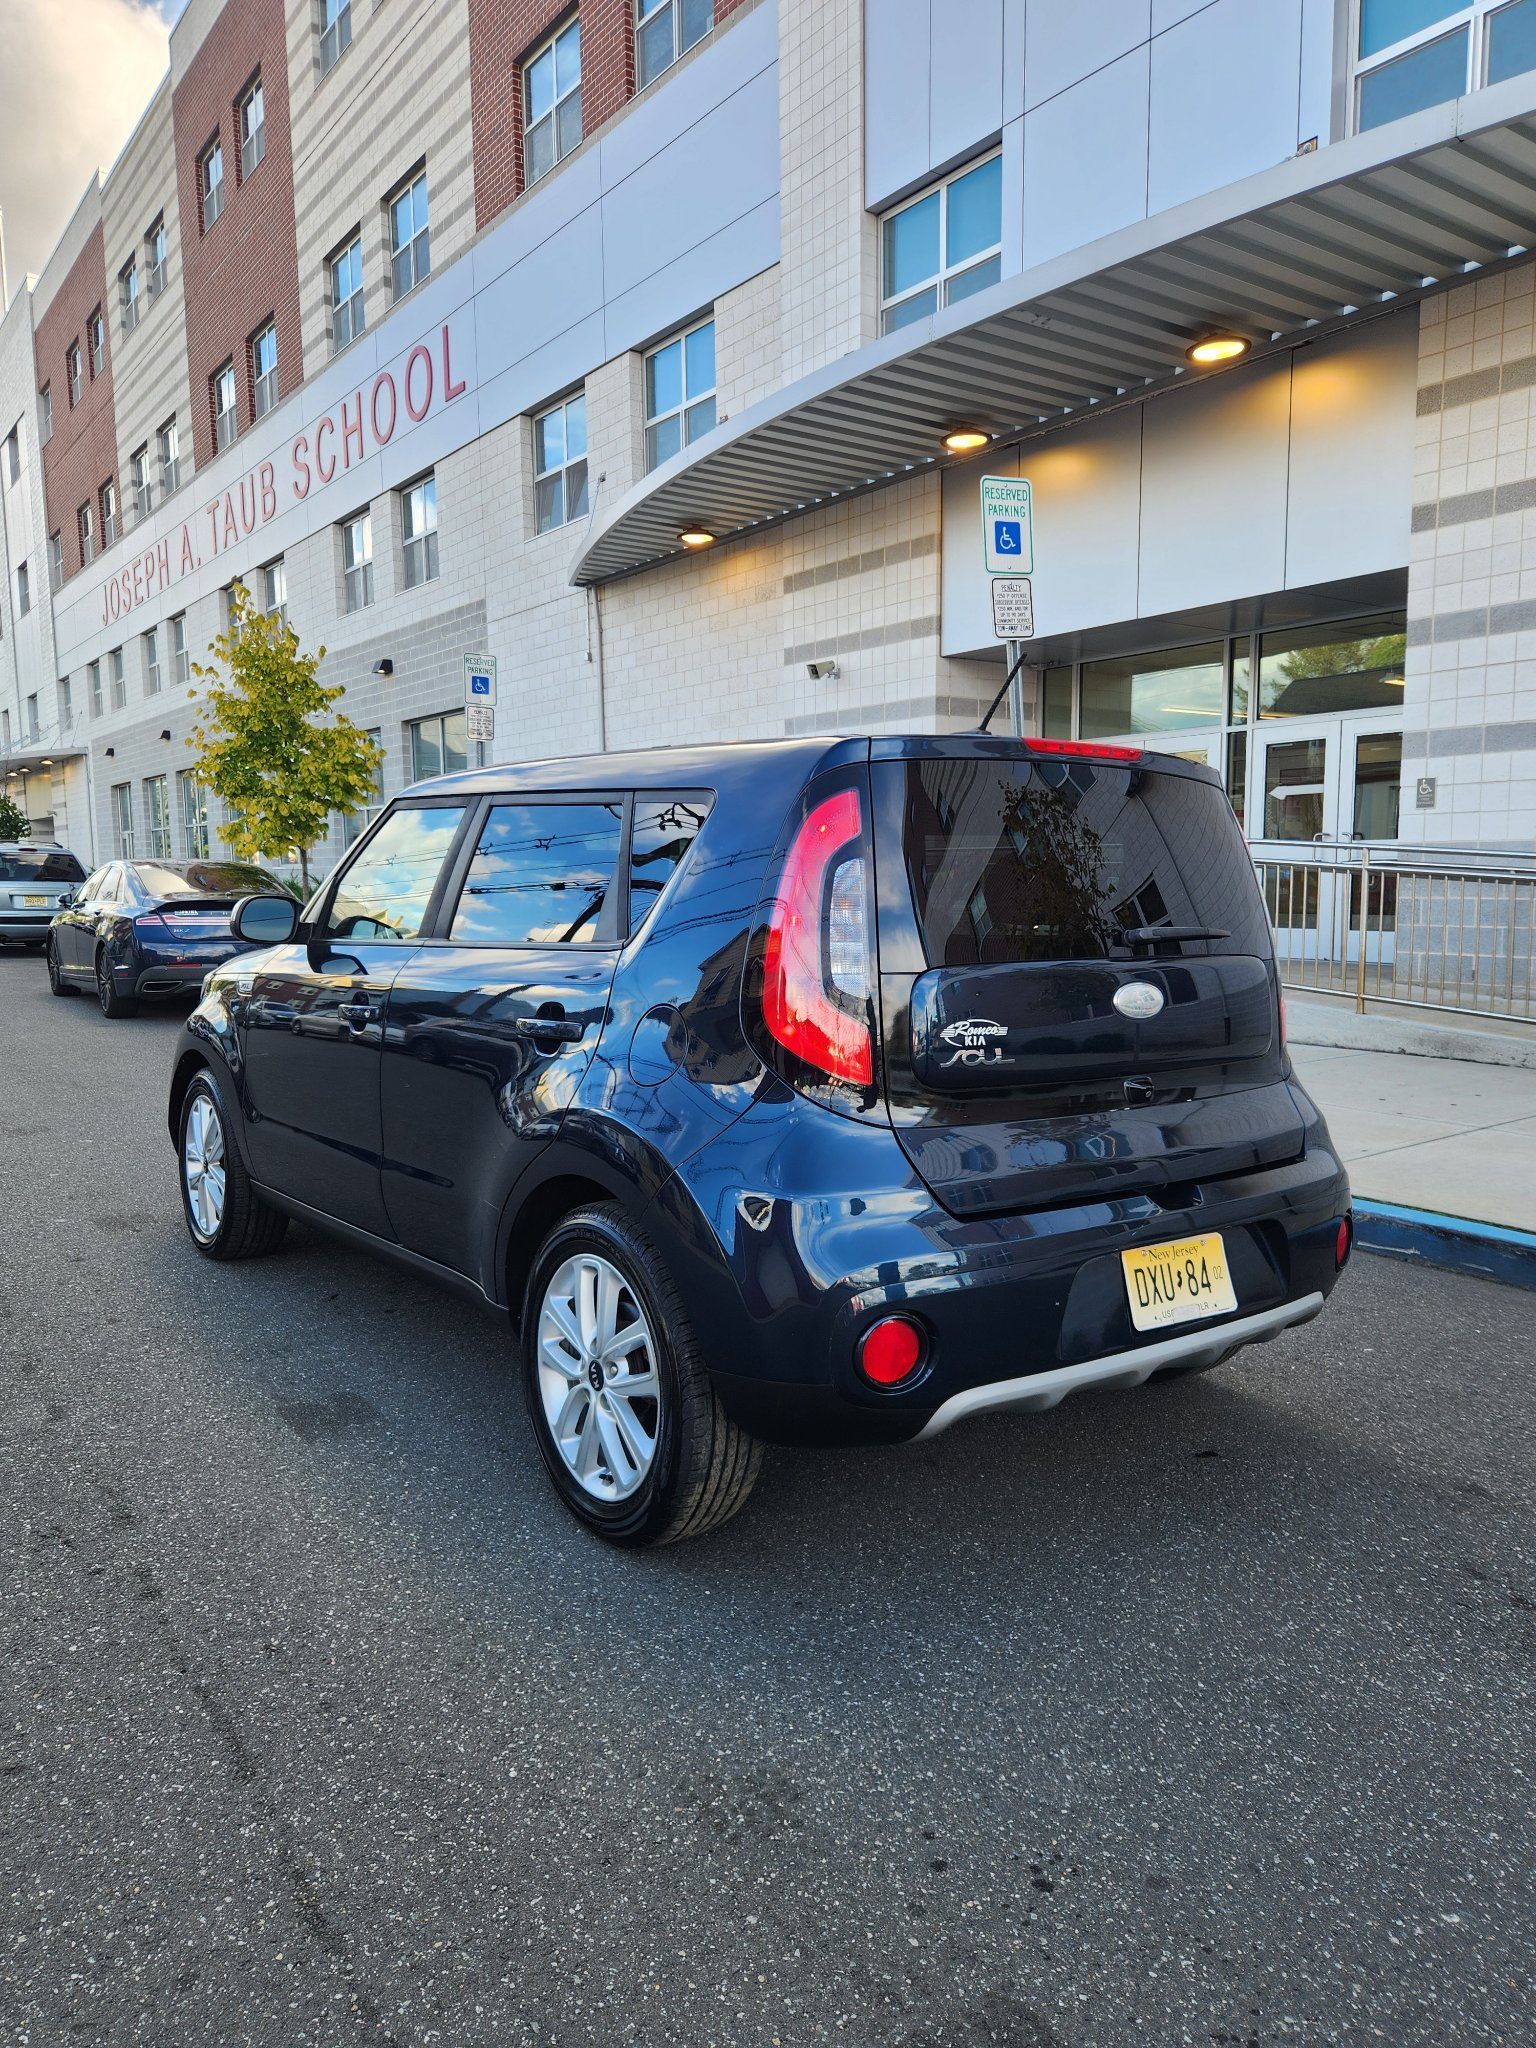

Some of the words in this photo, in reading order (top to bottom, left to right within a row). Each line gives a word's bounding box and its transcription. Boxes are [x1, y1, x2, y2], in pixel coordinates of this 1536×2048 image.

[101, 538, 170, 626] JOSEPH
[180, 523, 201, 577] A.
[206, 461, 276, 555] TAUB
[292, 324, 466, 500] SCHOOL
[984, 486, 1028, 501] RESERVED
[988, 504, 1026, 518] PARKING
[465, 657, 494, 667] RESERVED
[467, 666, 493, 675] PARKING
[954, 1020, 998, 1036] Romeo
[964, 1035, 986, 1046] KIA
[1148, 1248, 1171, 1262] New
[1172, 1245, 1199, 1260] Jersey
[590, 1362, 600, 1389] KIA
